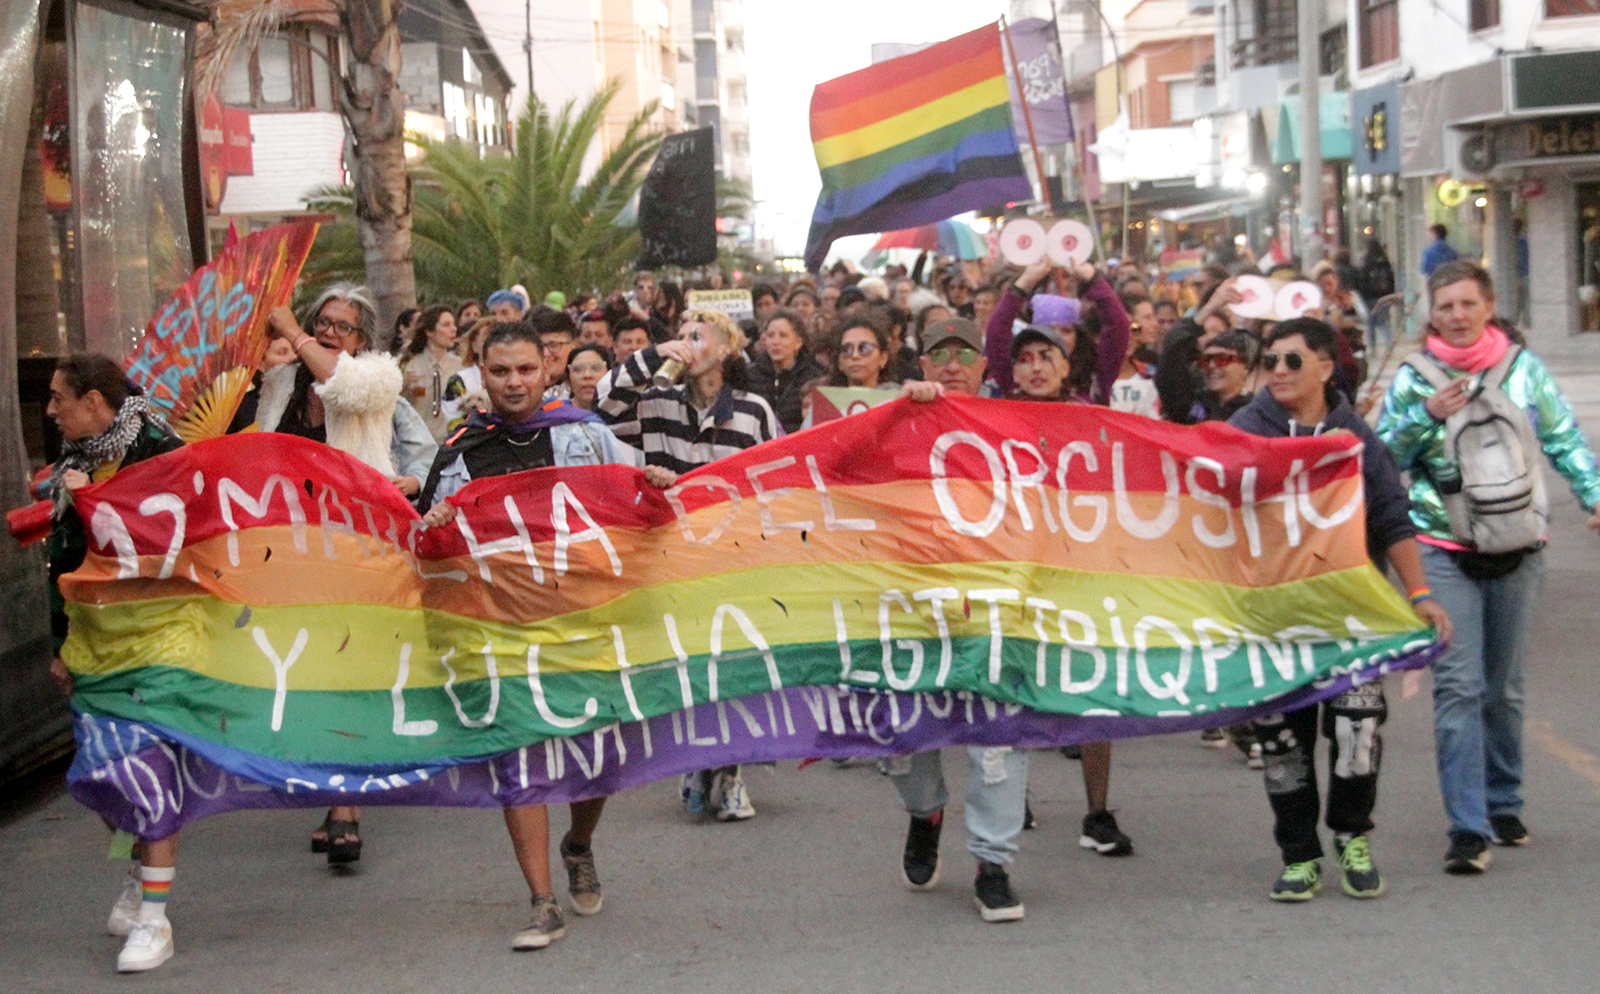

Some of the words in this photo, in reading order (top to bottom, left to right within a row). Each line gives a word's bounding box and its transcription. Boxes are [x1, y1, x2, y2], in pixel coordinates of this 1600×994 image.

[664, 455, 876, 546] DEL
[252, 627, 309, 731] Y
[391, 604, 783, 736] LUCHA
